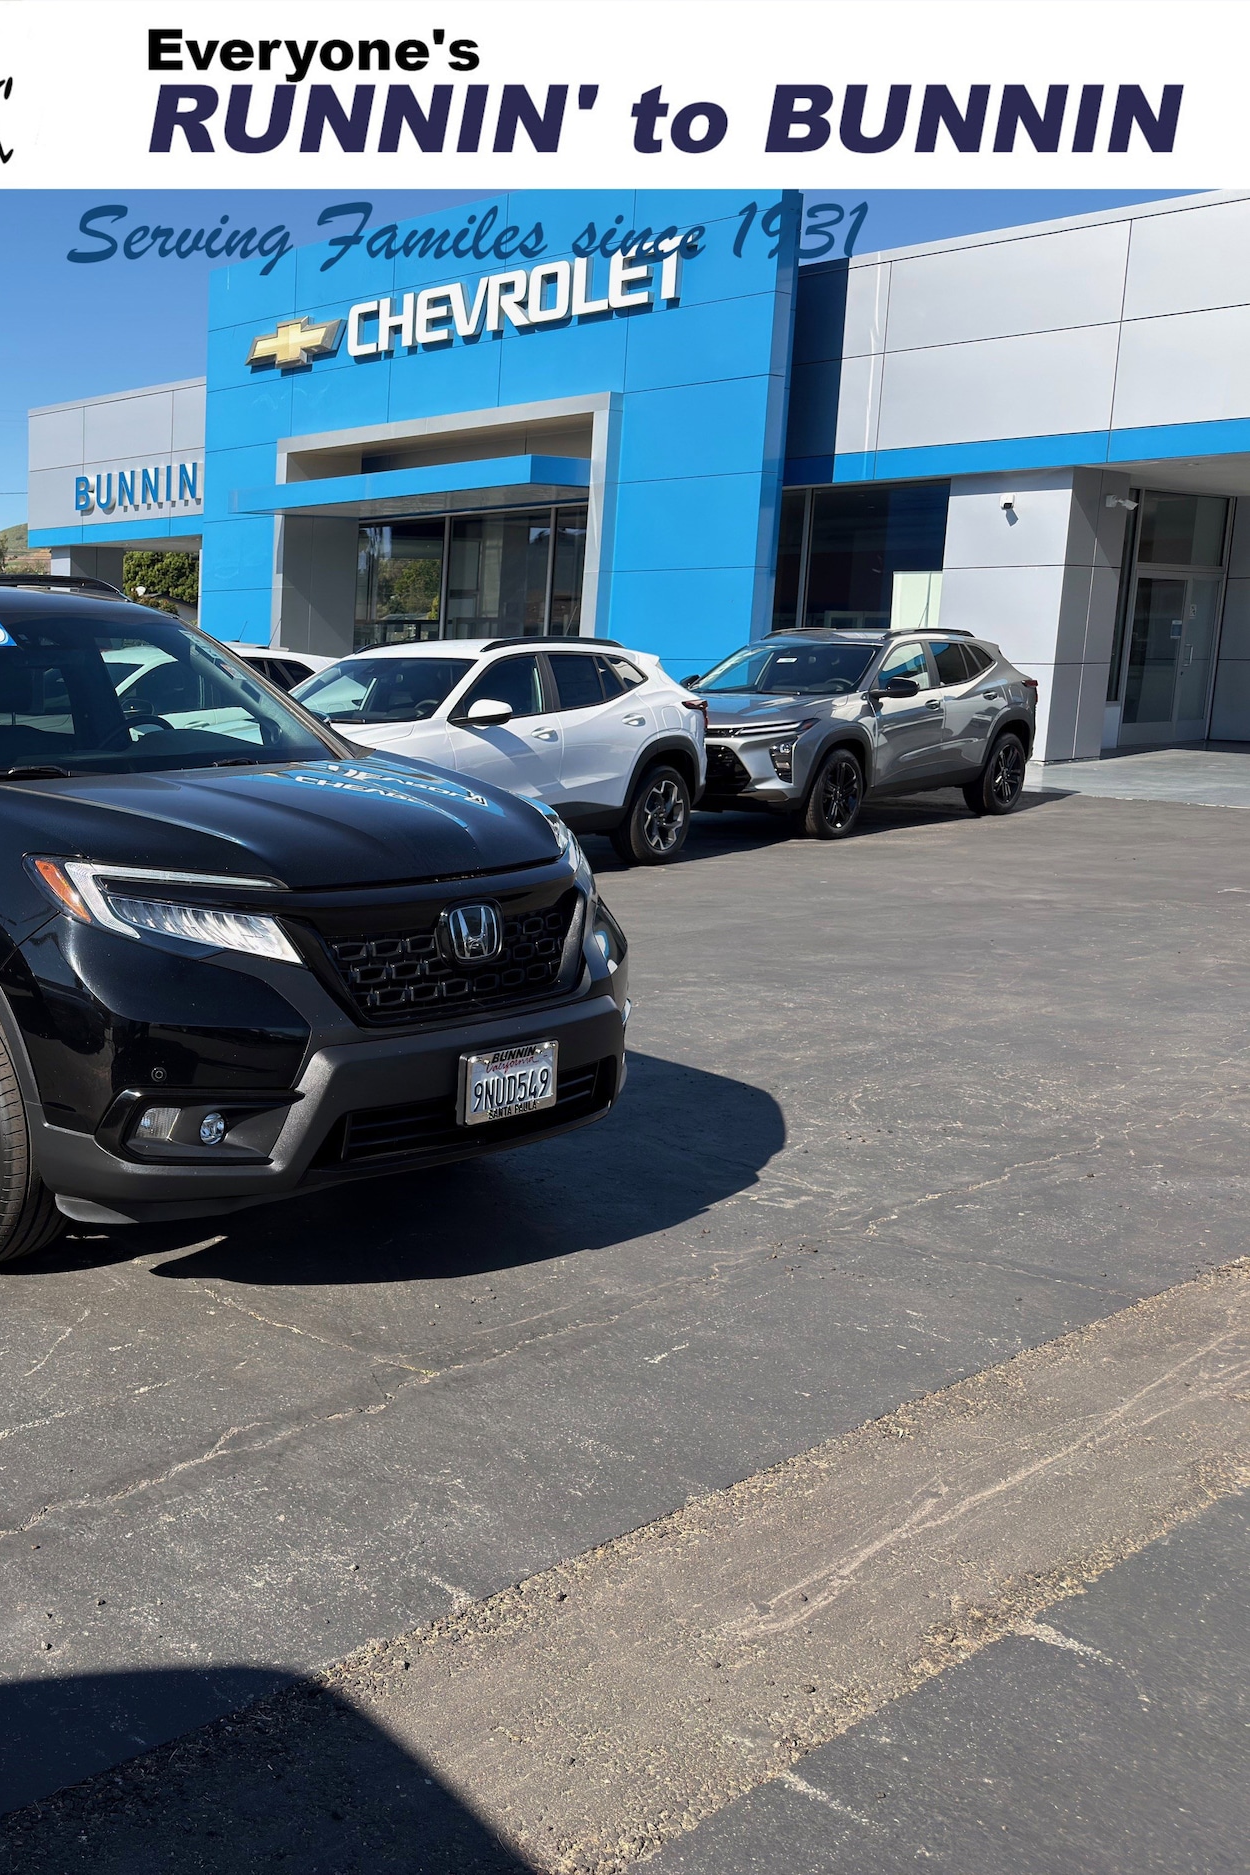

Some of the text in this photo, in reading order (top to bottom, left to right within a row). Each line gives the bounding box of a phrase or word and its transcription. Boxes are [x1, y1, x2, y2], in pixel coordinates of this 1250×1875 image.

[347, 233, 699, 358] CHEVROLET
[75, 461, 200, 512] BUNNIN
[492, 1046, 537, 1064] BUNNIN
[473, 1067, 549, 1113] 9NUD549
[488, 1101, 537, 1120] SANTA PAULA
